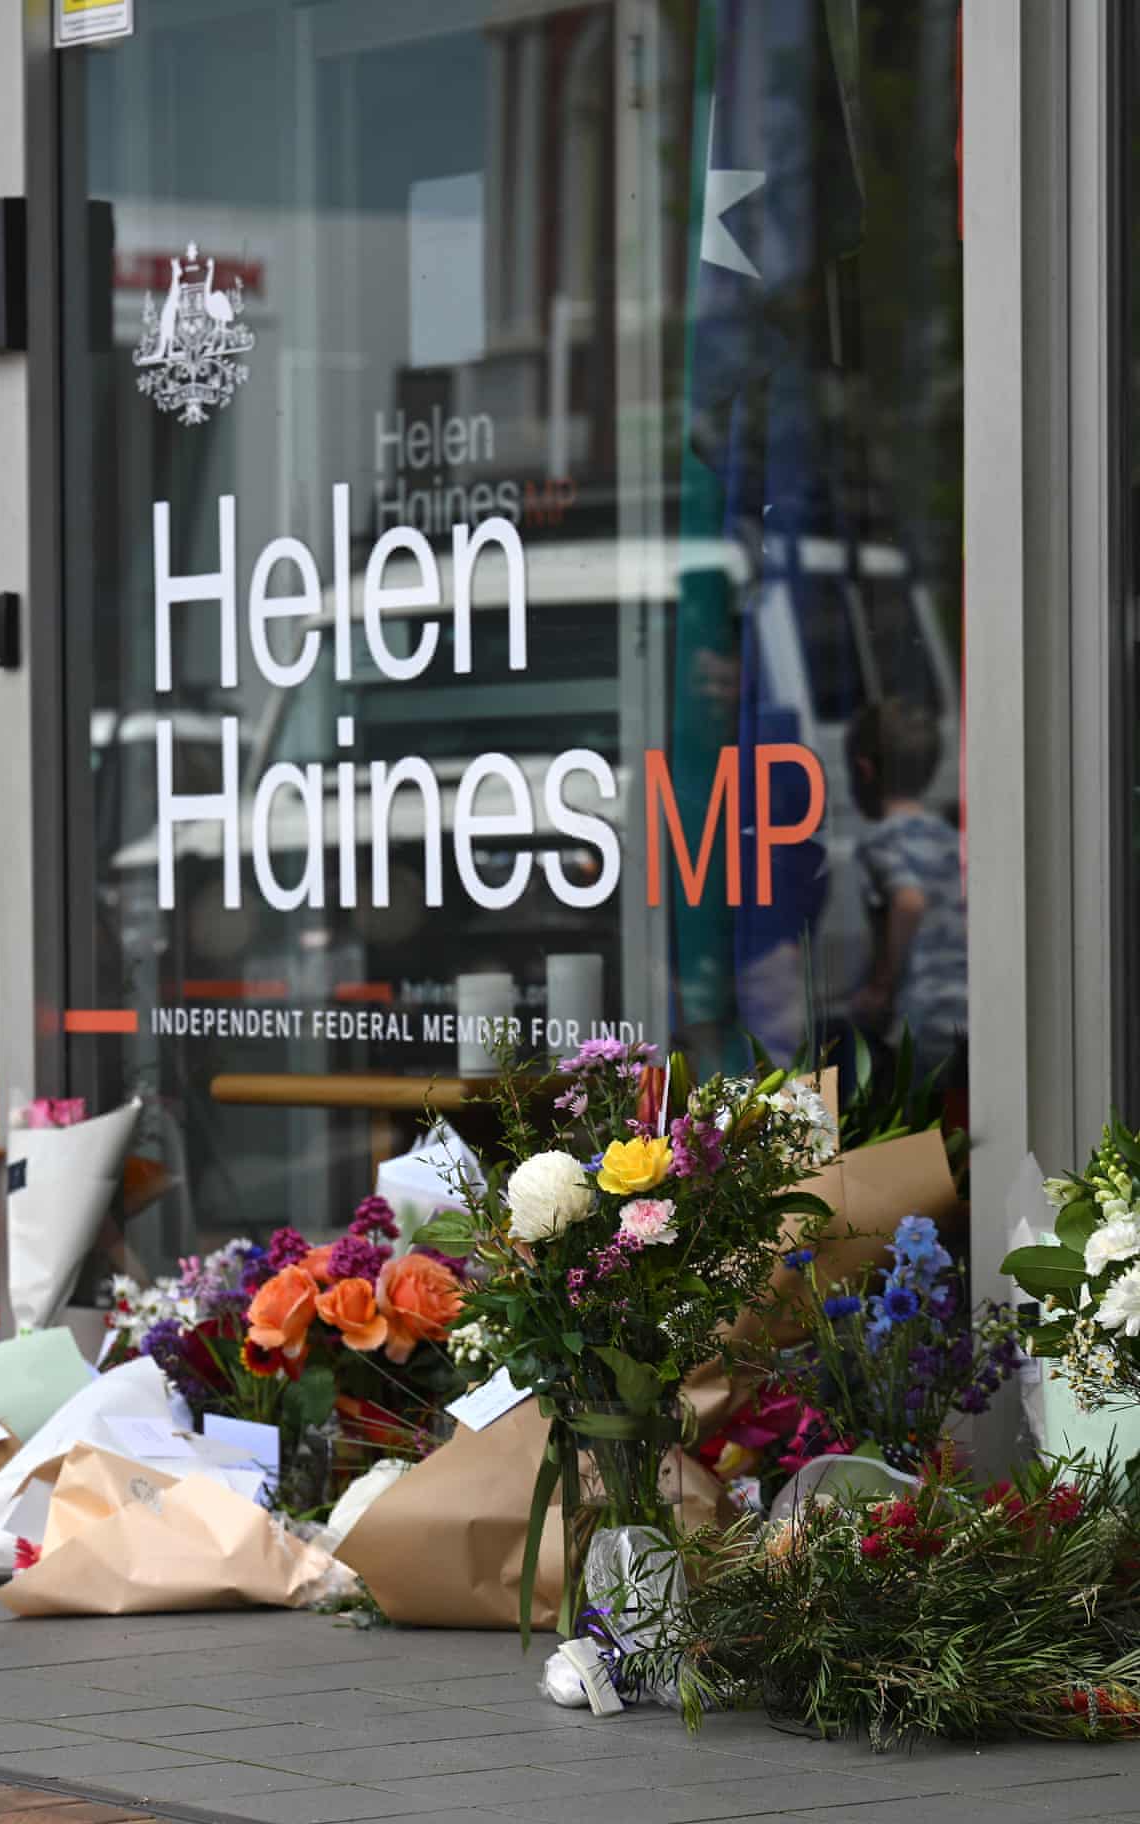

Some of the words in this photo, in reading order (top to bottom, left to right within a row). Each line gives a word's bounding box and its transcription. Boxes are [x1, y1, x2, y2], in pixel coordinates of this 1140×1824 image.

[374, 404, 495, 473] Helen
[153, 483, 527, 692] Helen
[156, 717, 621, 911] Haines
[644, 743, 826, 907] MP
[151, 1007, 303, 1038] INDEPENDENT
[313, 1011, 413, 1041] FEDERAL
[423, 1013, 523, 1046] MEMBER
[531, 1017, 581, 1048] FOR
